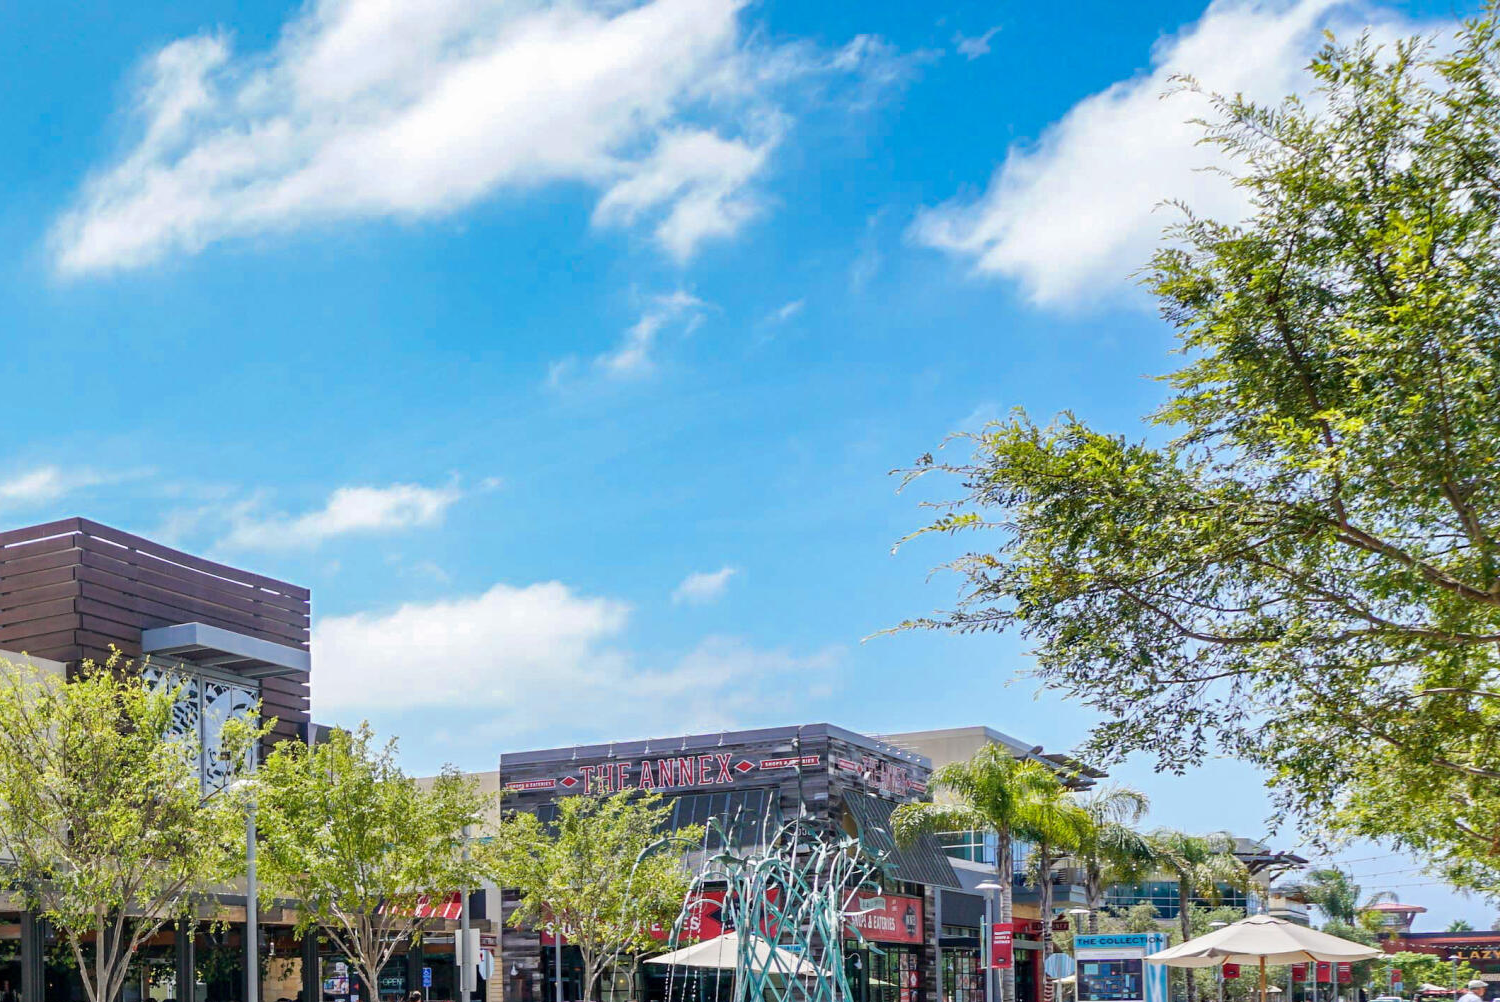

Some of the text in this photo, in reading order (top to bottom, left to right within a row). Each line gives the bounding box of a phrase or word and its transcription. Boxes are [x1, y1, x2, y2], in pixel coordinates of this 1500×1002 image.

[579, 753, 733, 795] THE ANNEX
[1099, 937, 1164, 945] COLLECTION
